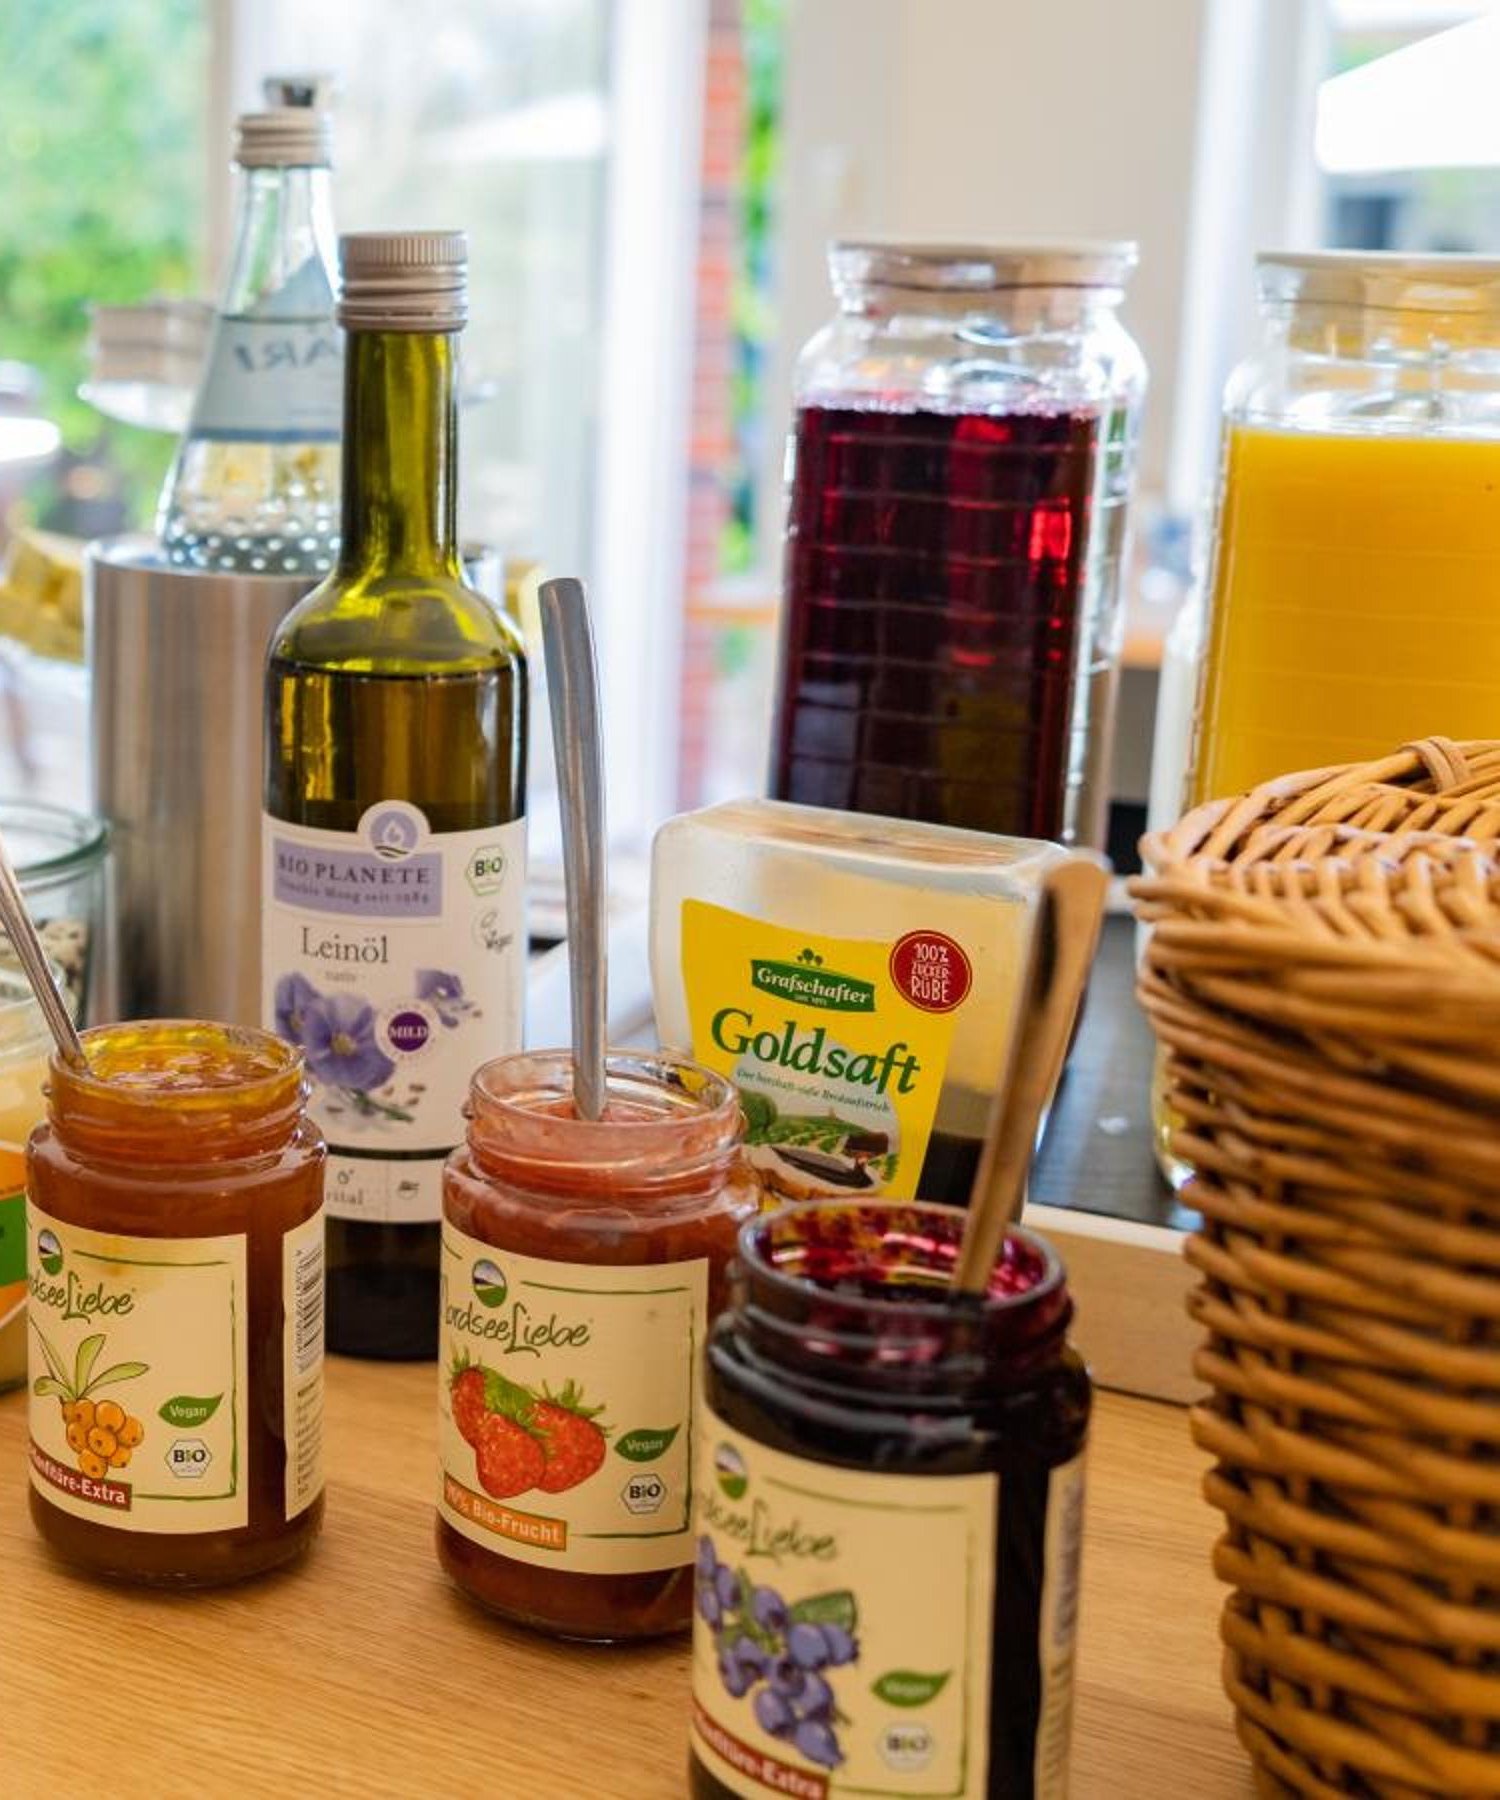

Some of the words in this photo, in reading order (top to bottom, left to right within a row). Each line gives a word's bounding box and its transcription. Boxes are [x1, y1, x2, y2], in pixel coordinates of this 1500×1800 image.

[277, 852, 309, 877] BIO
[315, 862, 431, 886] PLANETE
[302, 926, 389, 965] Leinöl
[756, 966, 871, 1005] Grafschafter
[910, 977, 950, 1004] RÜBE
[389, 1024, 428, 1039] MILD
[710, 1007, 921, 1096] Goldsaft
[169, 1403, 208, 1419] Vegan
[626, 1438, 664, 1454] Vegan
